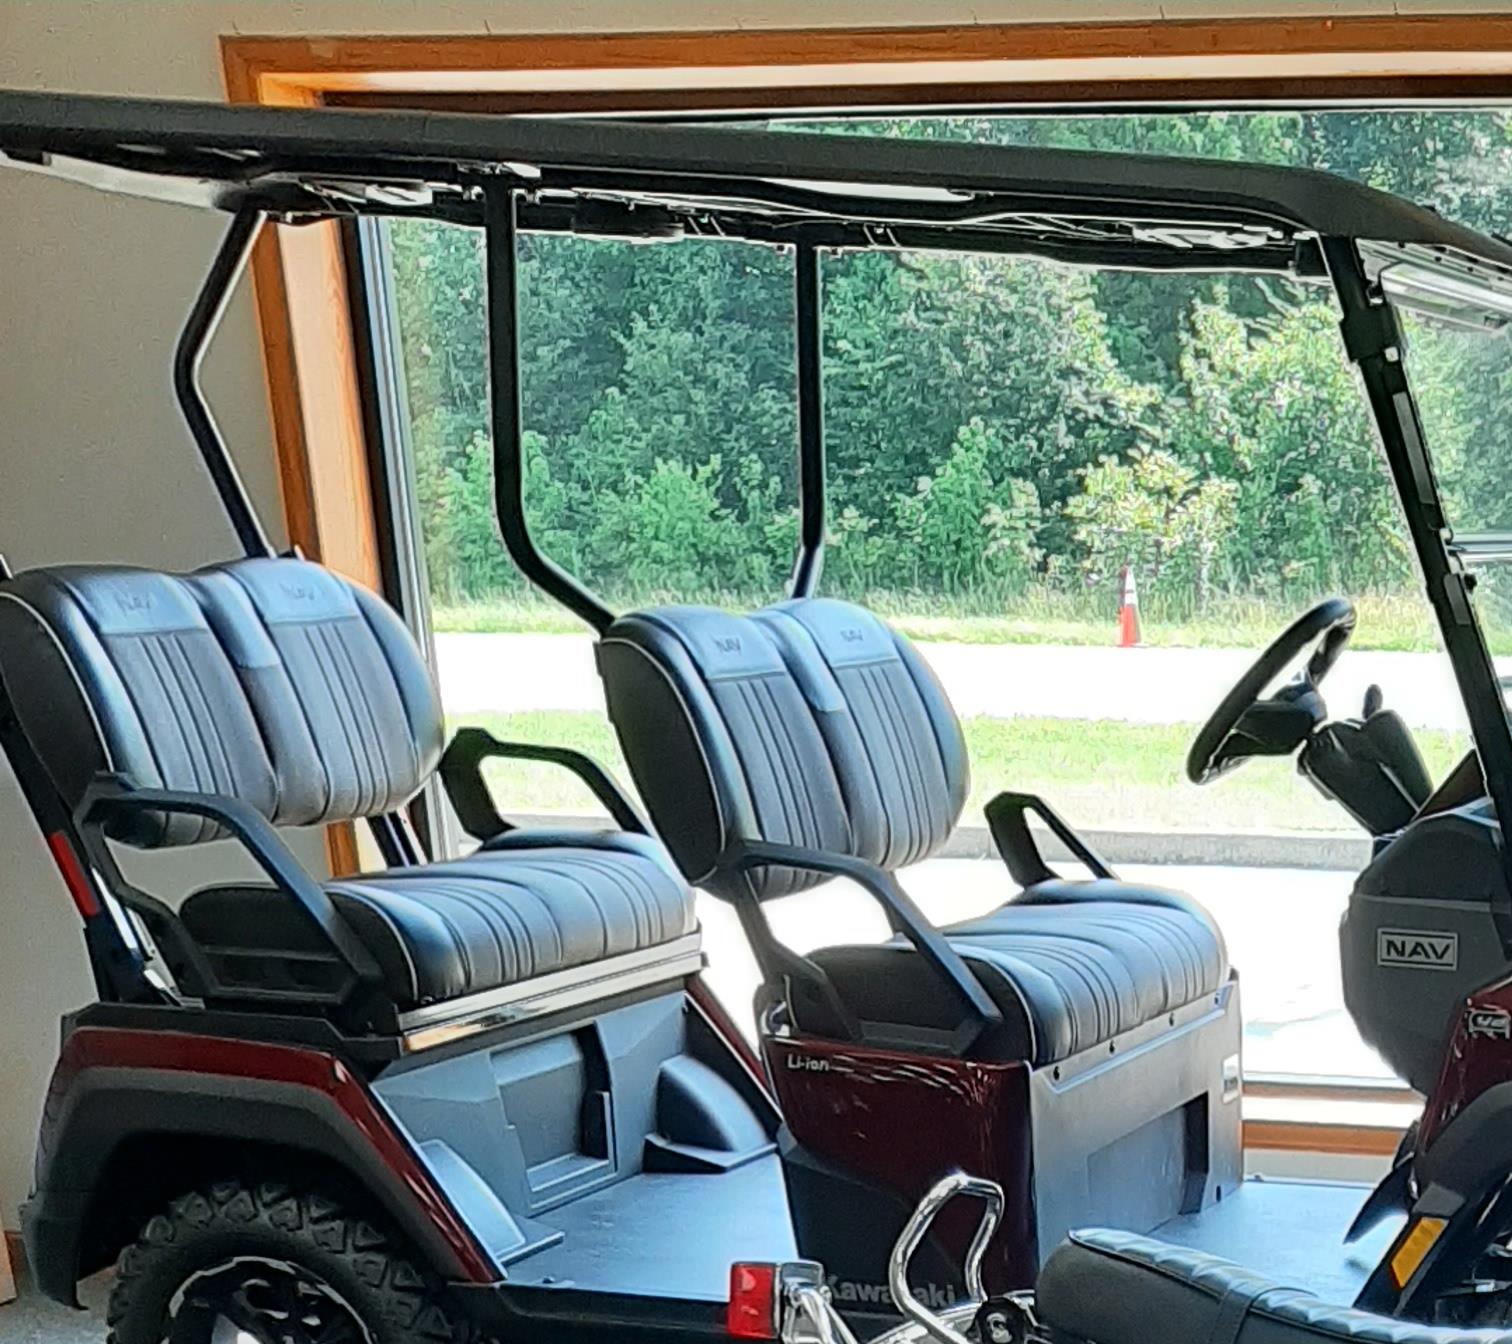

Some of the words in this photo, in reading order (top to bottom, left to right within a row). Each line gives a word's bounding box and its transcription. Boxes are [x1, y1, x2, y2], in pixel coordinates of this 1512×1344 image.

[1386, 939, 1451, 960] NAV
[787, 1052, 830, 1072] Li-ion
[827, 1274, 956, 1308] Kawaaki
